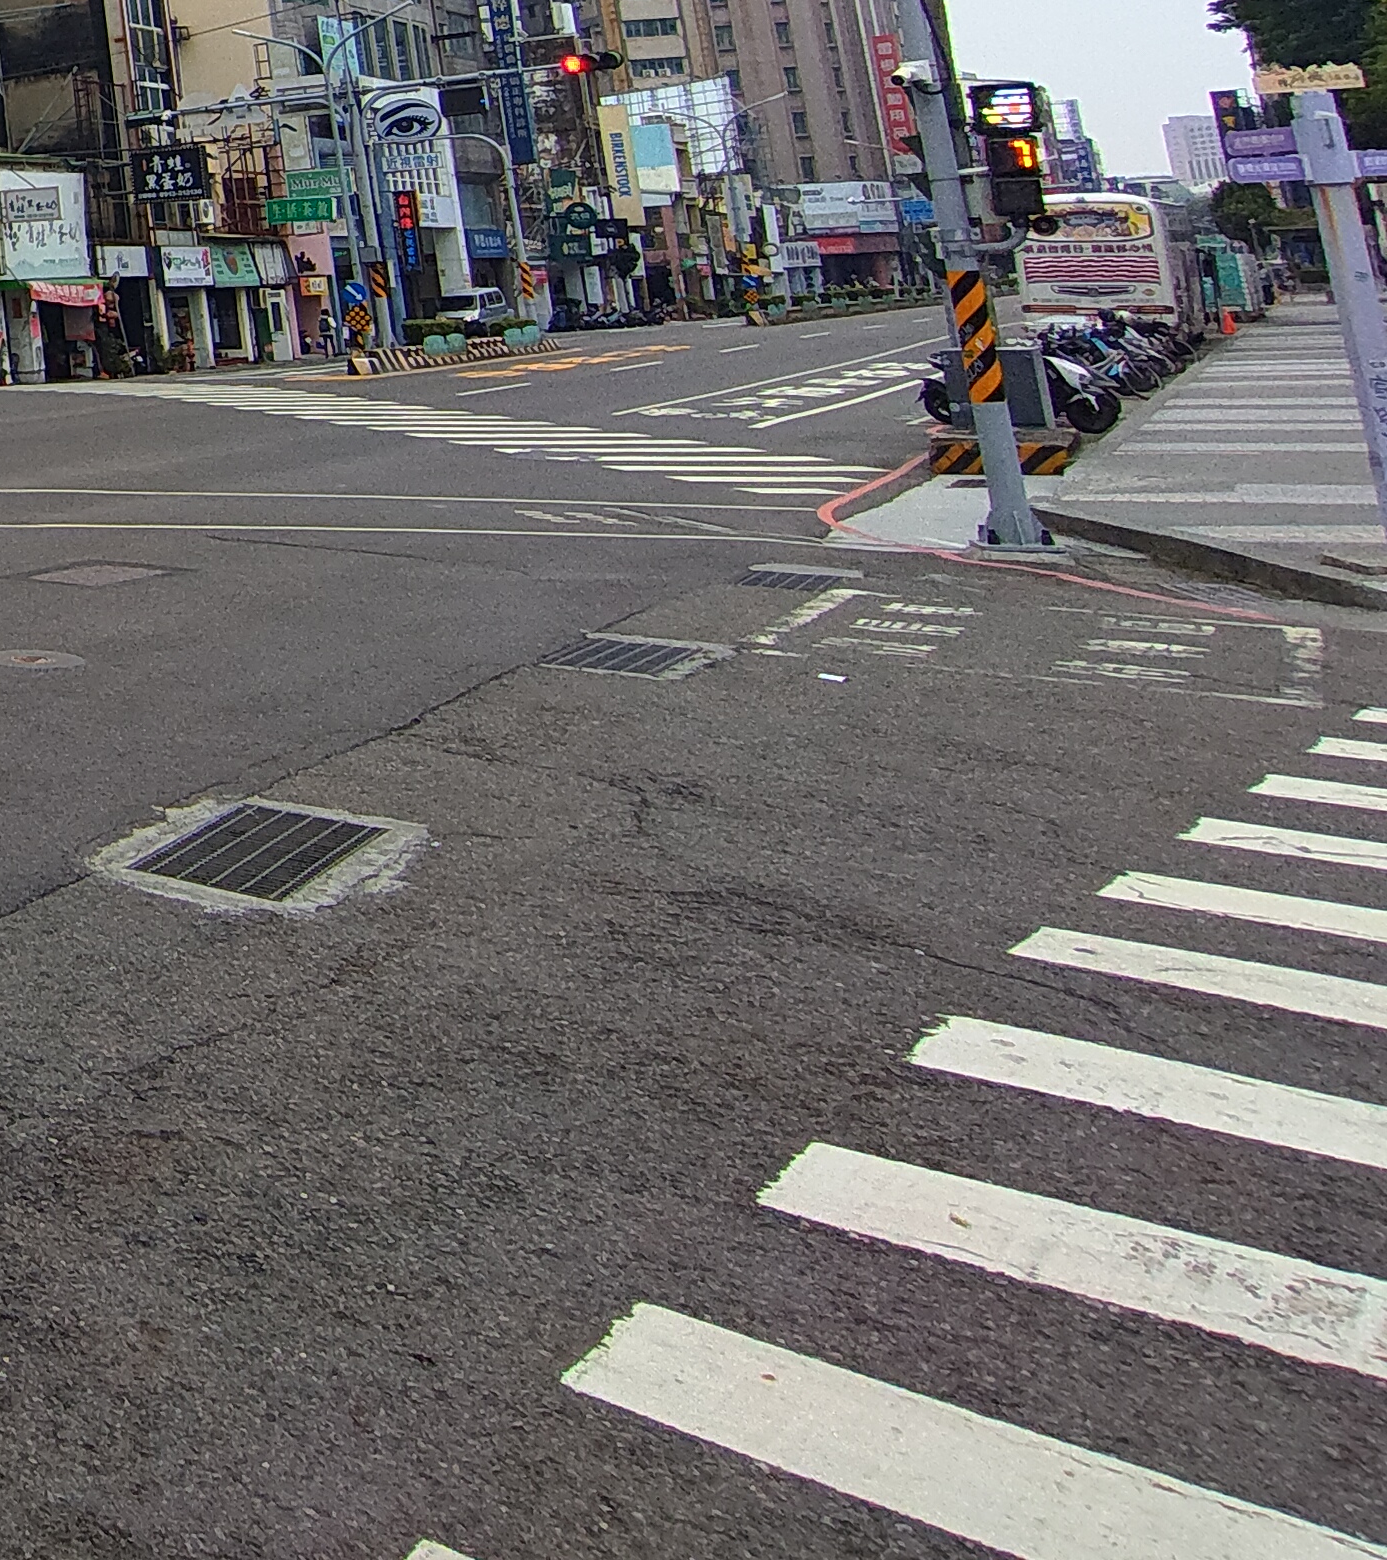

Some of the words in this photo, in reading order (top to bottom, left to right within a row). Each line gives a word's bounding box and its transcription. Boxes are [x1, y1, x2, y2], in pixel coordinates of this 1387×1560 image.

[387, 154, 439, 170] 近視雷射
[608, 131, 632, 198] BIRKENSTOCK
